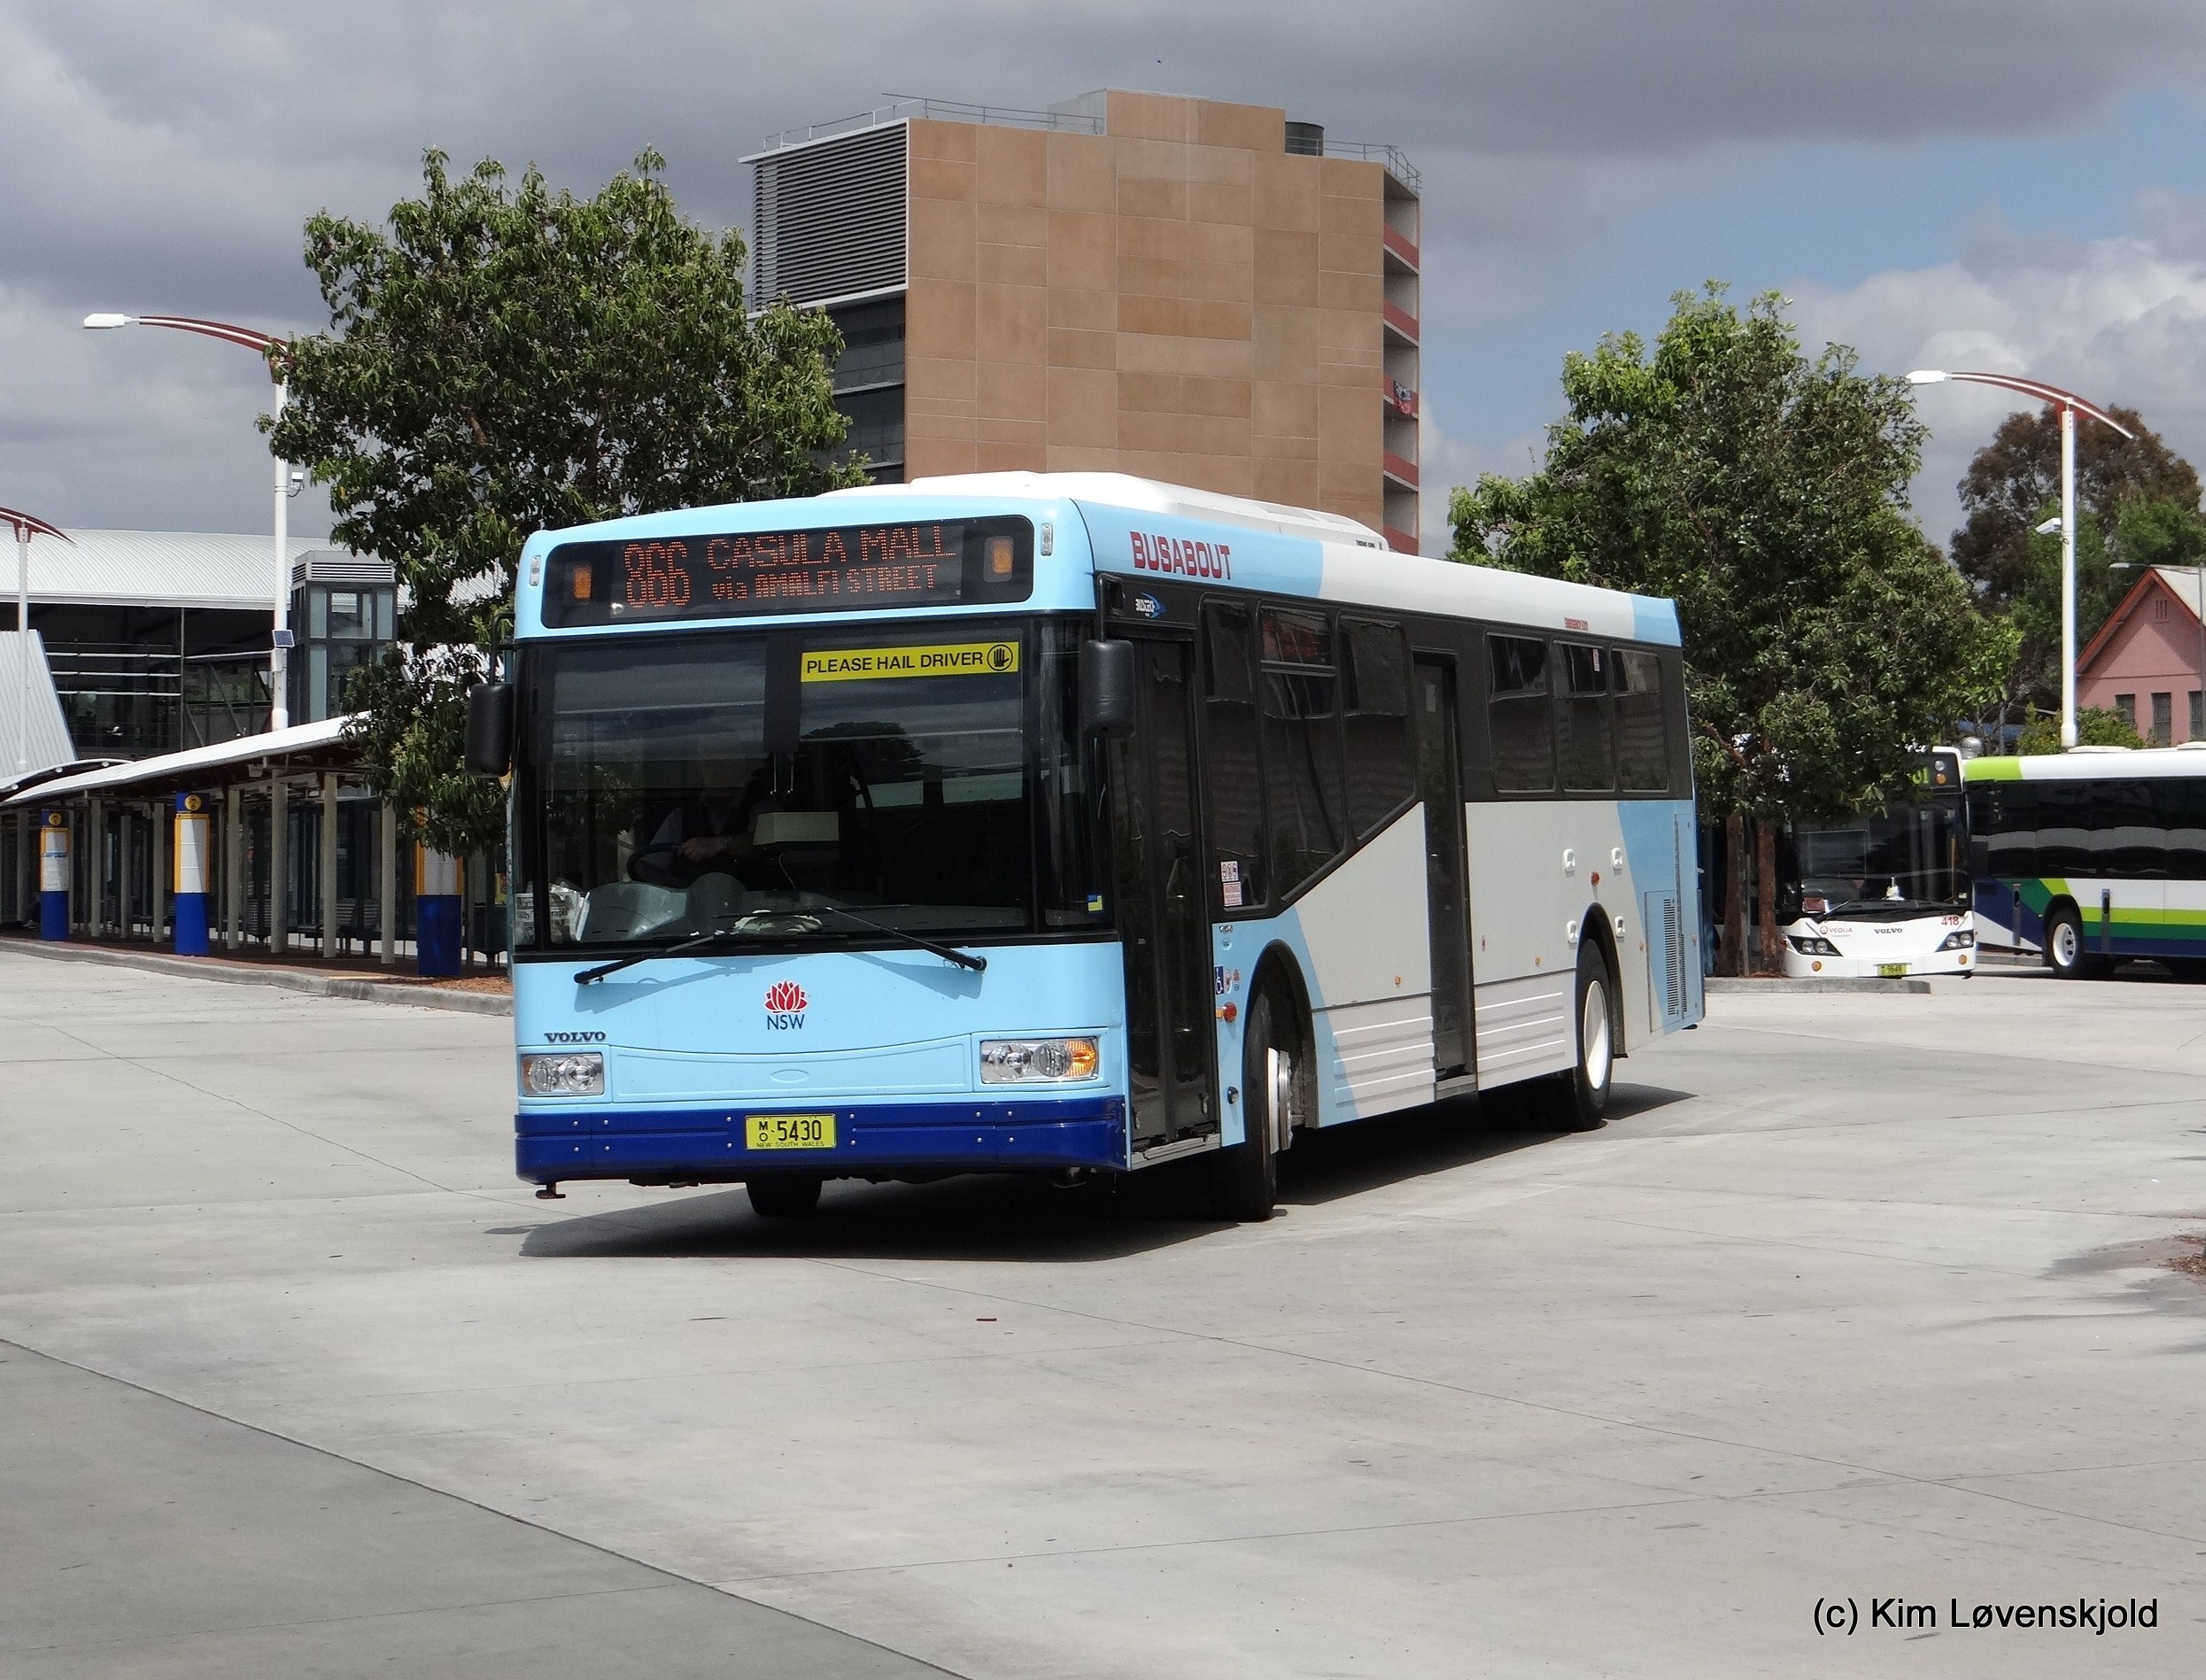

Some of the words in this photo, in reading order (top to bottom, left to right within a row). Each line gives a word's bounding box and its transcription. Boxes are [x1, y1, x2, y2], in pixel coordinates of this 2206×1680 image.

[708, 530, 848, 569] CASULA
[860, 525, 956, 561] MALL
[1129, 530, 1231, 580] BUSABOUT
[623, 540, 691, 608] 866
[711, 577, 748, 600] via
[847, 563, 939, 593] STREET
[806, 657, 872, 674] PLEASE
[877, 654, 916, 670] HAIL
[920, 651, 984, 668] DRIVER
[1940, 916, 1960, 926] 418
[767, 1014, 805, 1031] NSW
[544, 1031, 607, 1043] VOLVO
[777, 1119, 822, 1142] 5430
